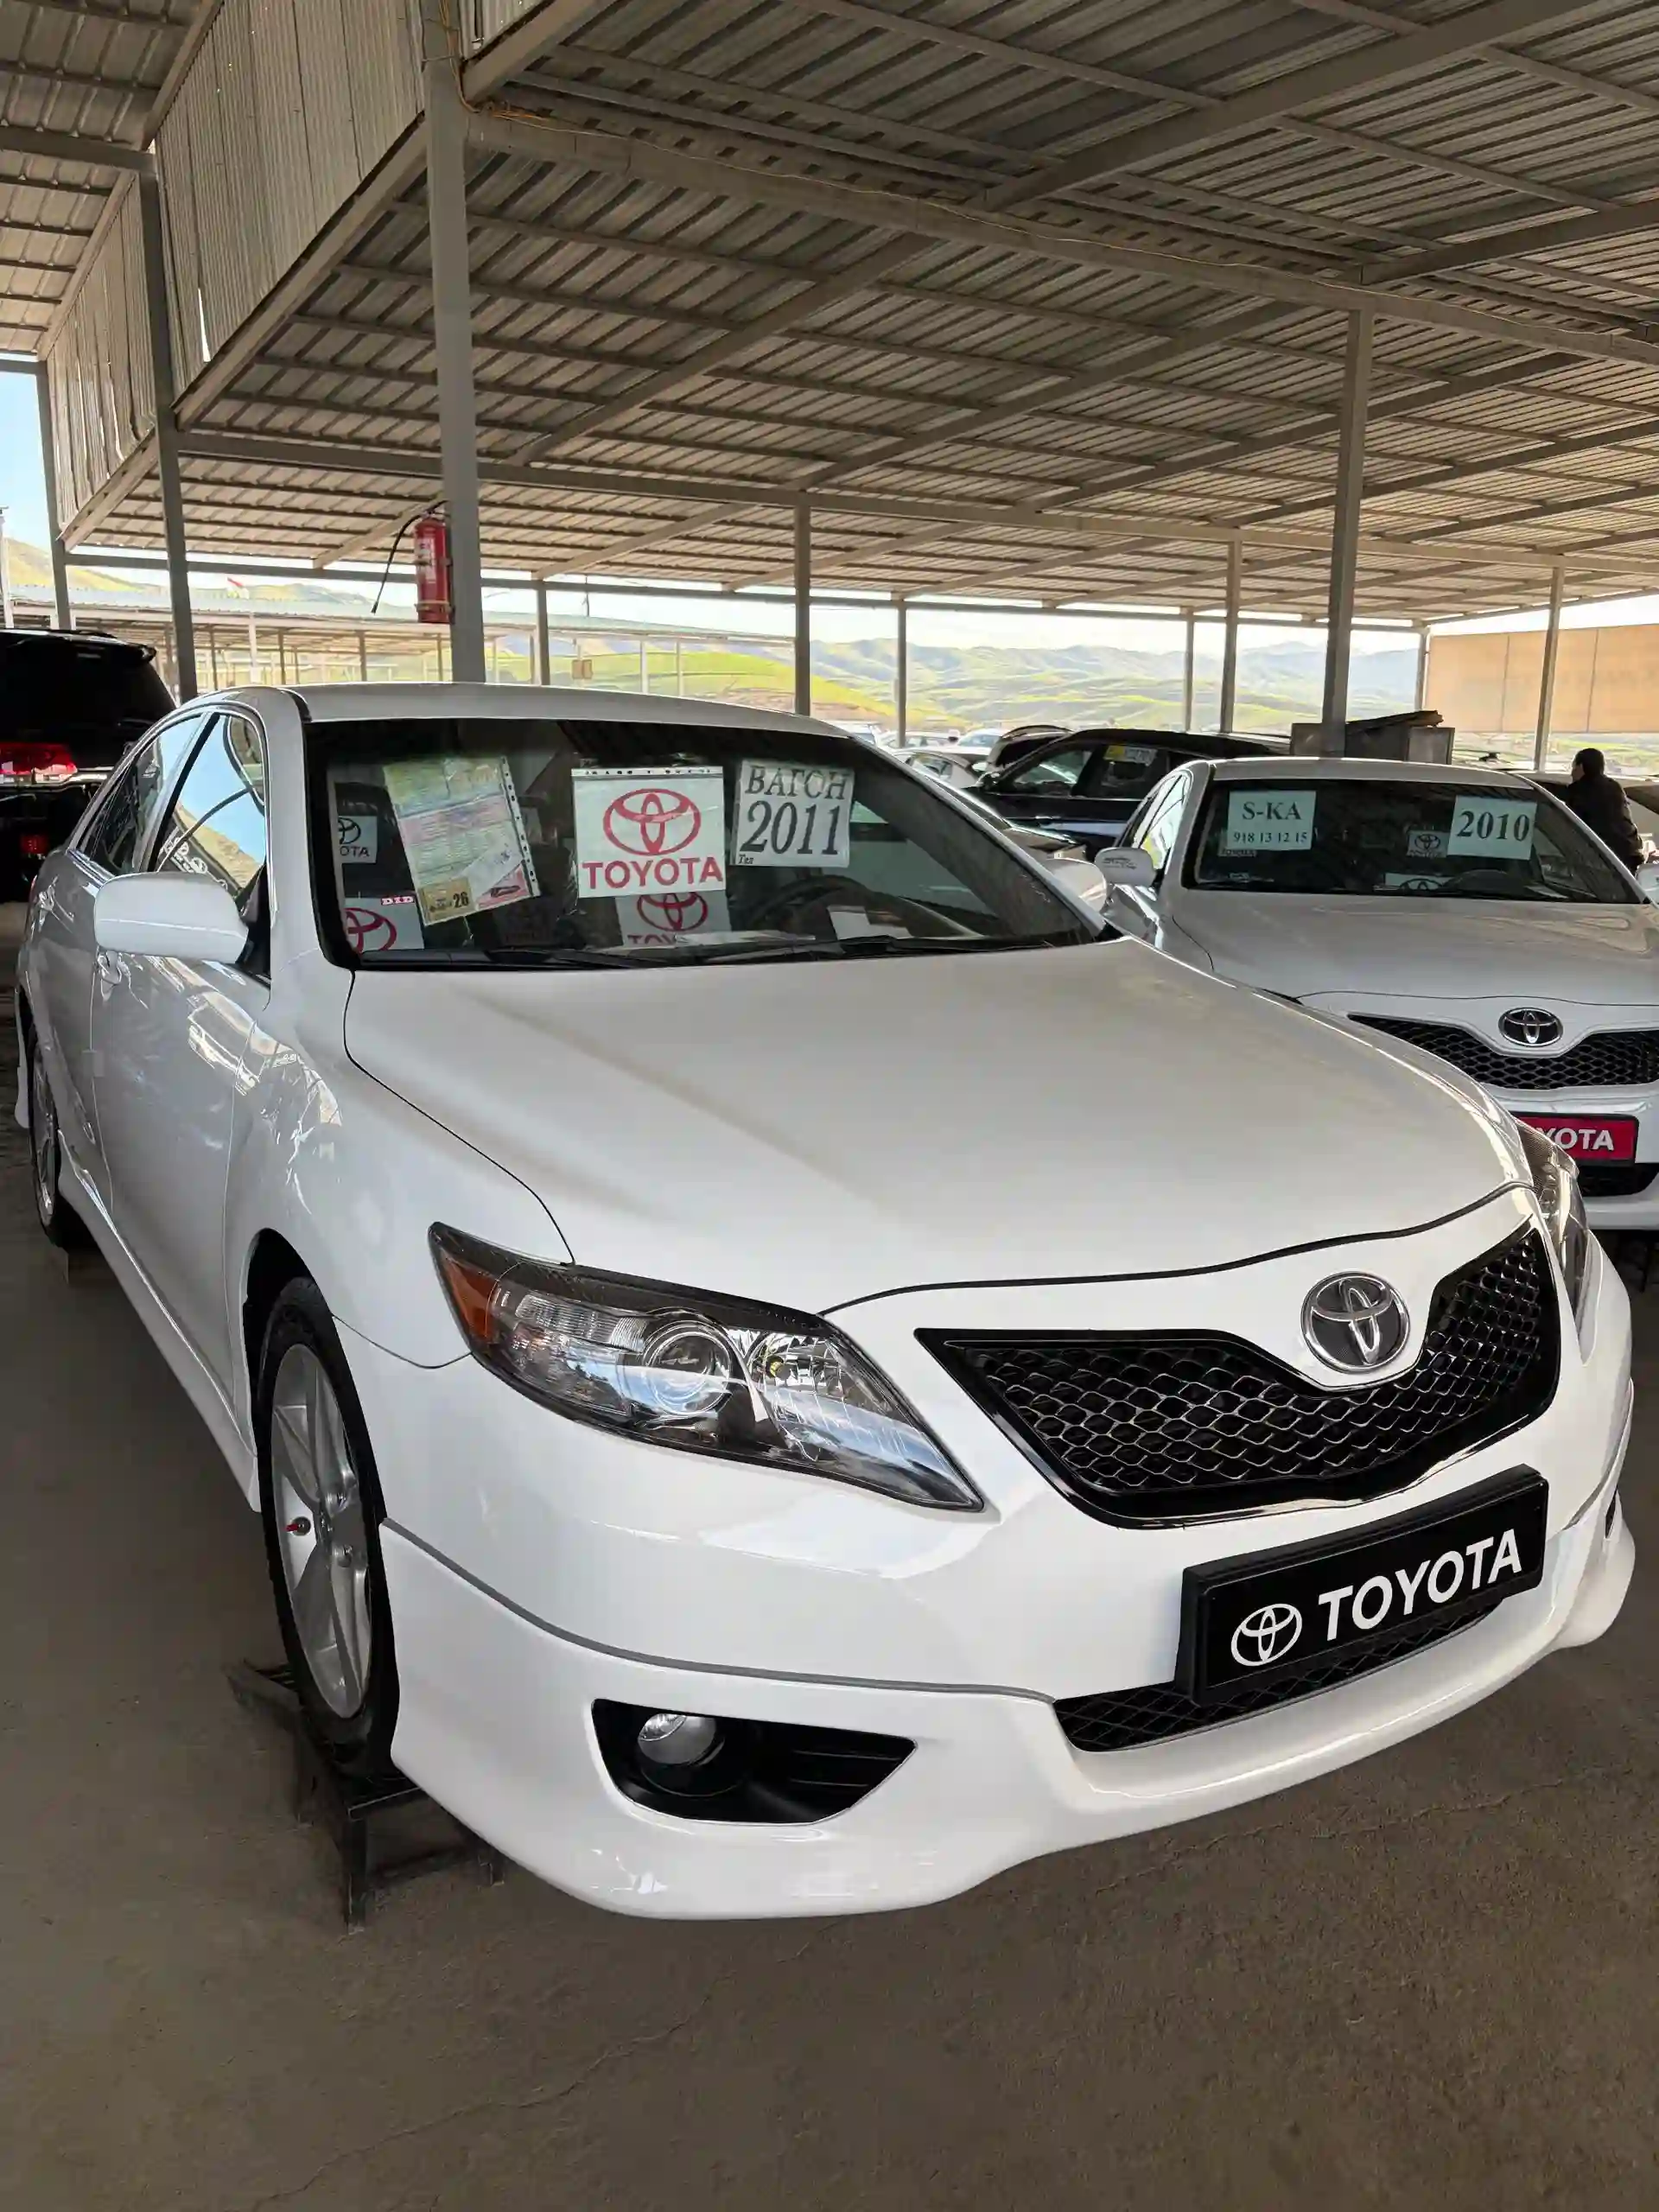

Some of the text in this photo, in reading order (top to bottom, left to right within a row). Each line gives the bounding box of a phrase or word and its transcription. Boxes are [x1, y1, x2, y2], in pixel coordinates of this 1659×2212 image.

[1242, 800, 1302, 821] S-KA
[1456, 810, 1531, 842] 2010
[740, 800, 840, 855] 2011
[1233, 831, 1308, 844] 918 13 12 15
[582, 856, 723, 889] TOYOTA
[452, 890, 470, 909] 26
[1319, 1529, 1522, 1641] TOYOTA
